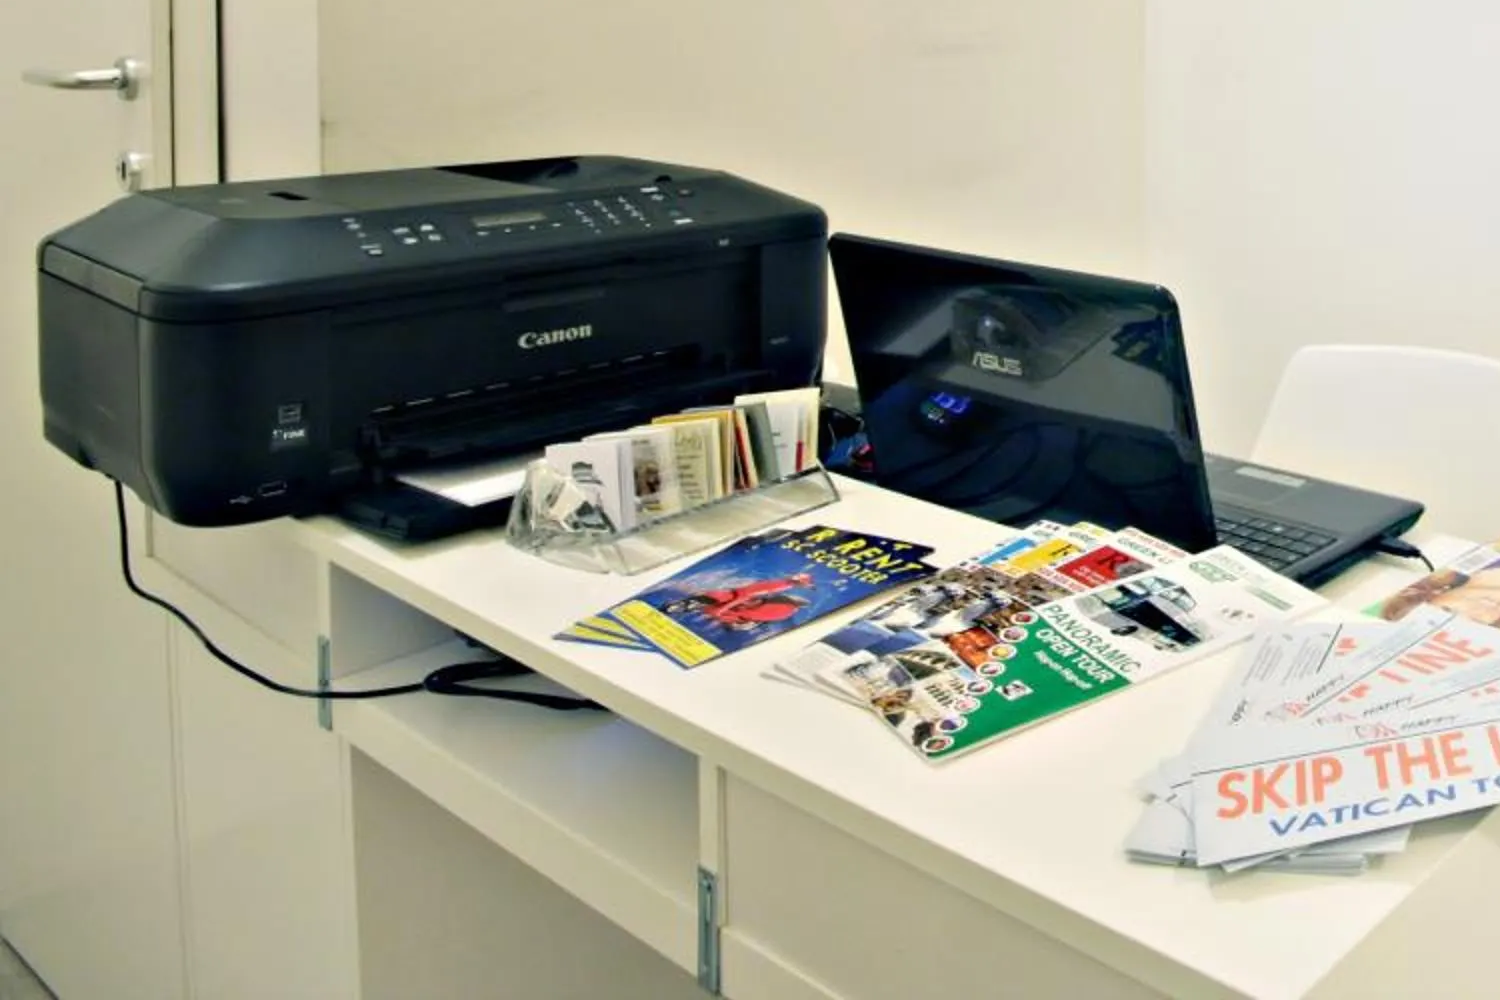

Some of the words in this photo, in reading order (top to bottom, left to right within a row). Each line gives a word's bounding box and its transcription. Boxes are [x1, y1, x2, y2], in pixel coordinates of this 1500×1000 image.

[517, 322, 592, 350] Canon
[972, 351, 1023, 377] ASUS
[833, 538, 924, 575] RENT
[1036, 628, 1080, 658] OPEN
[1072, 653, 1117, 684] TOUR
[1043, 604, 1141, 674] PANORAMIC
[1217, 756, 1344, 819] SKIP
[1365, 732, 1473, 791] THE
[1270, 785, 1457, 838] VATICAN
